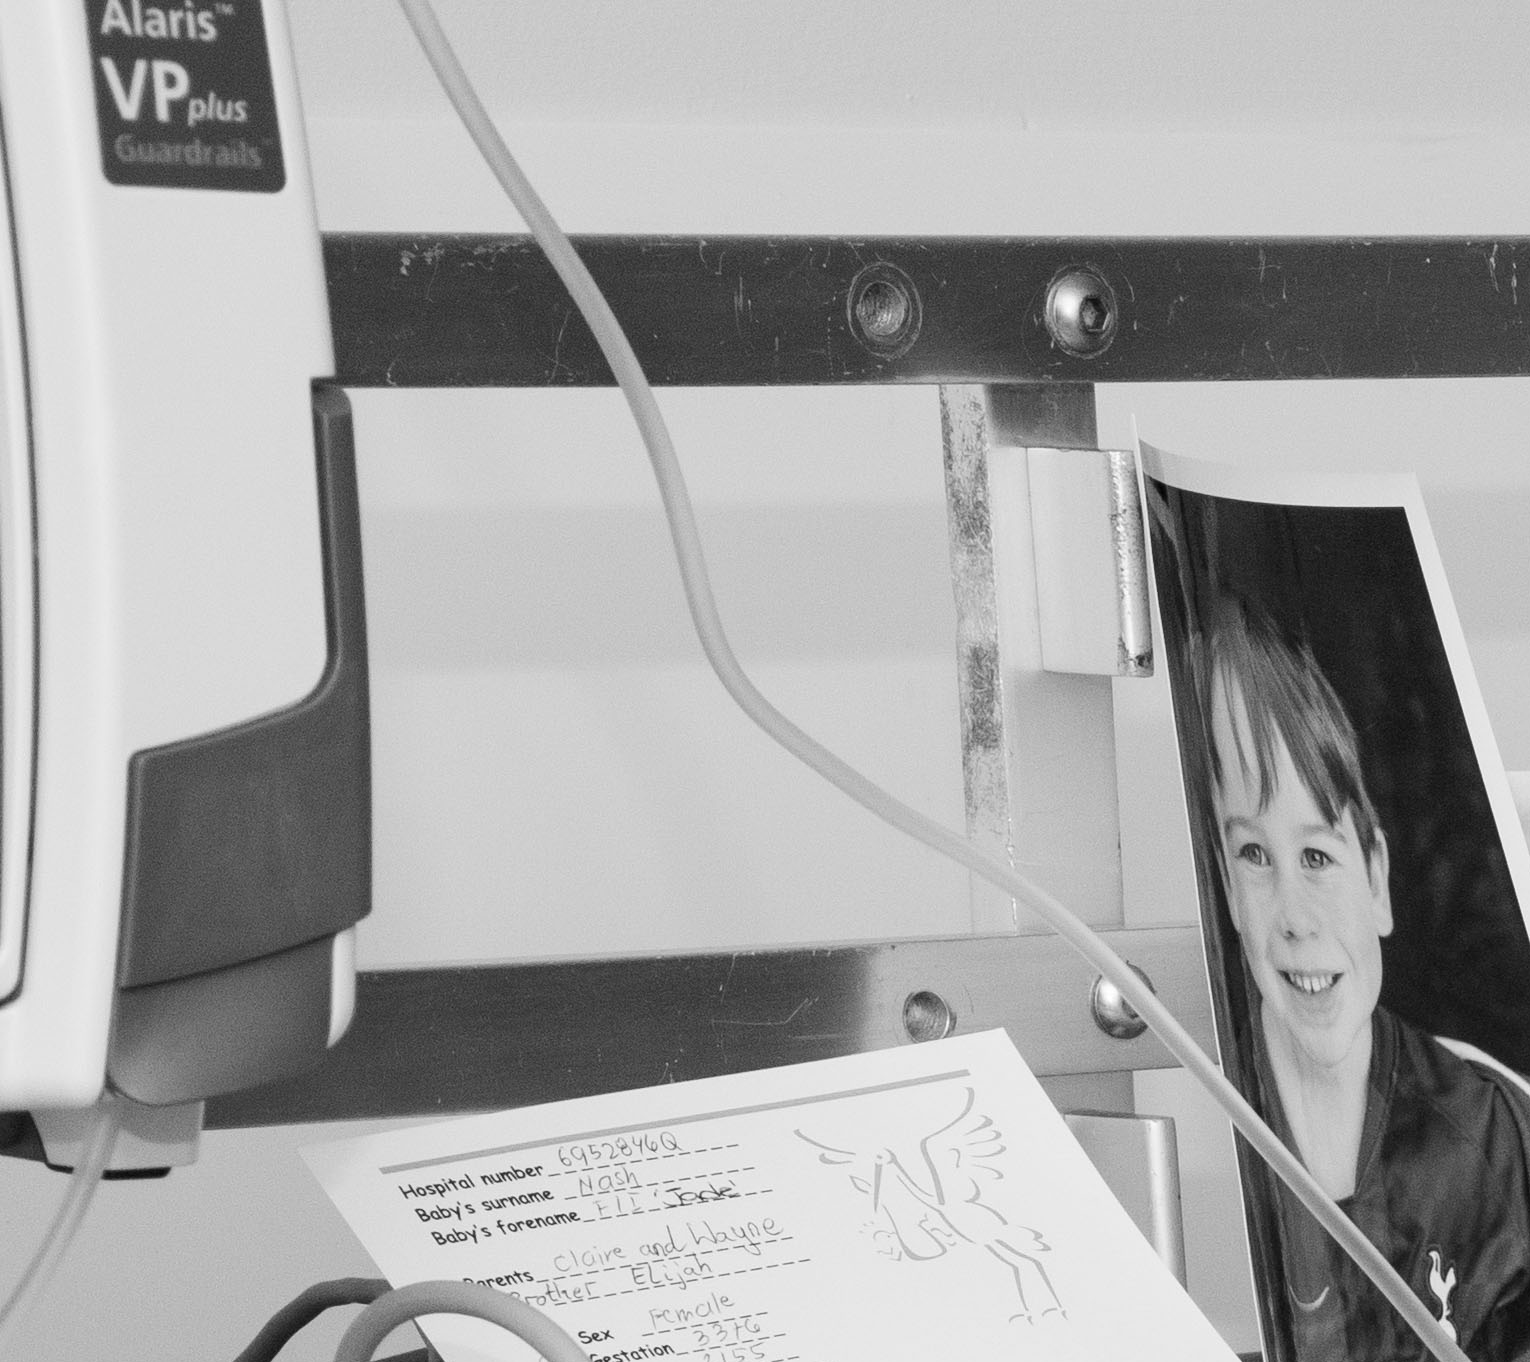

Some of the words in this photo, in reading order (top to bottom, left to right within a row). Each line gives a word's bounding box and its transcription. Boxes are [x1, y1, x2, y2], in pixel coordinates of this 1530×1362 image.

[399, 1175, 475, 1200] Hospital
[480, 1164, 543, 1188] number
[414, 1199, 476, 1223] Baby's
[482, 1188, 555, 1214] surname
[578, 1166, 640, 1197] Nash
[431, 1224, 492, 1247] Baby's
[496, 1209, 581, 1235] forename
[639, 1225, 685, 1257] and
[686, 1216, 785, 1257] Wayne
[578, 1329, 614, 1345] Sex
